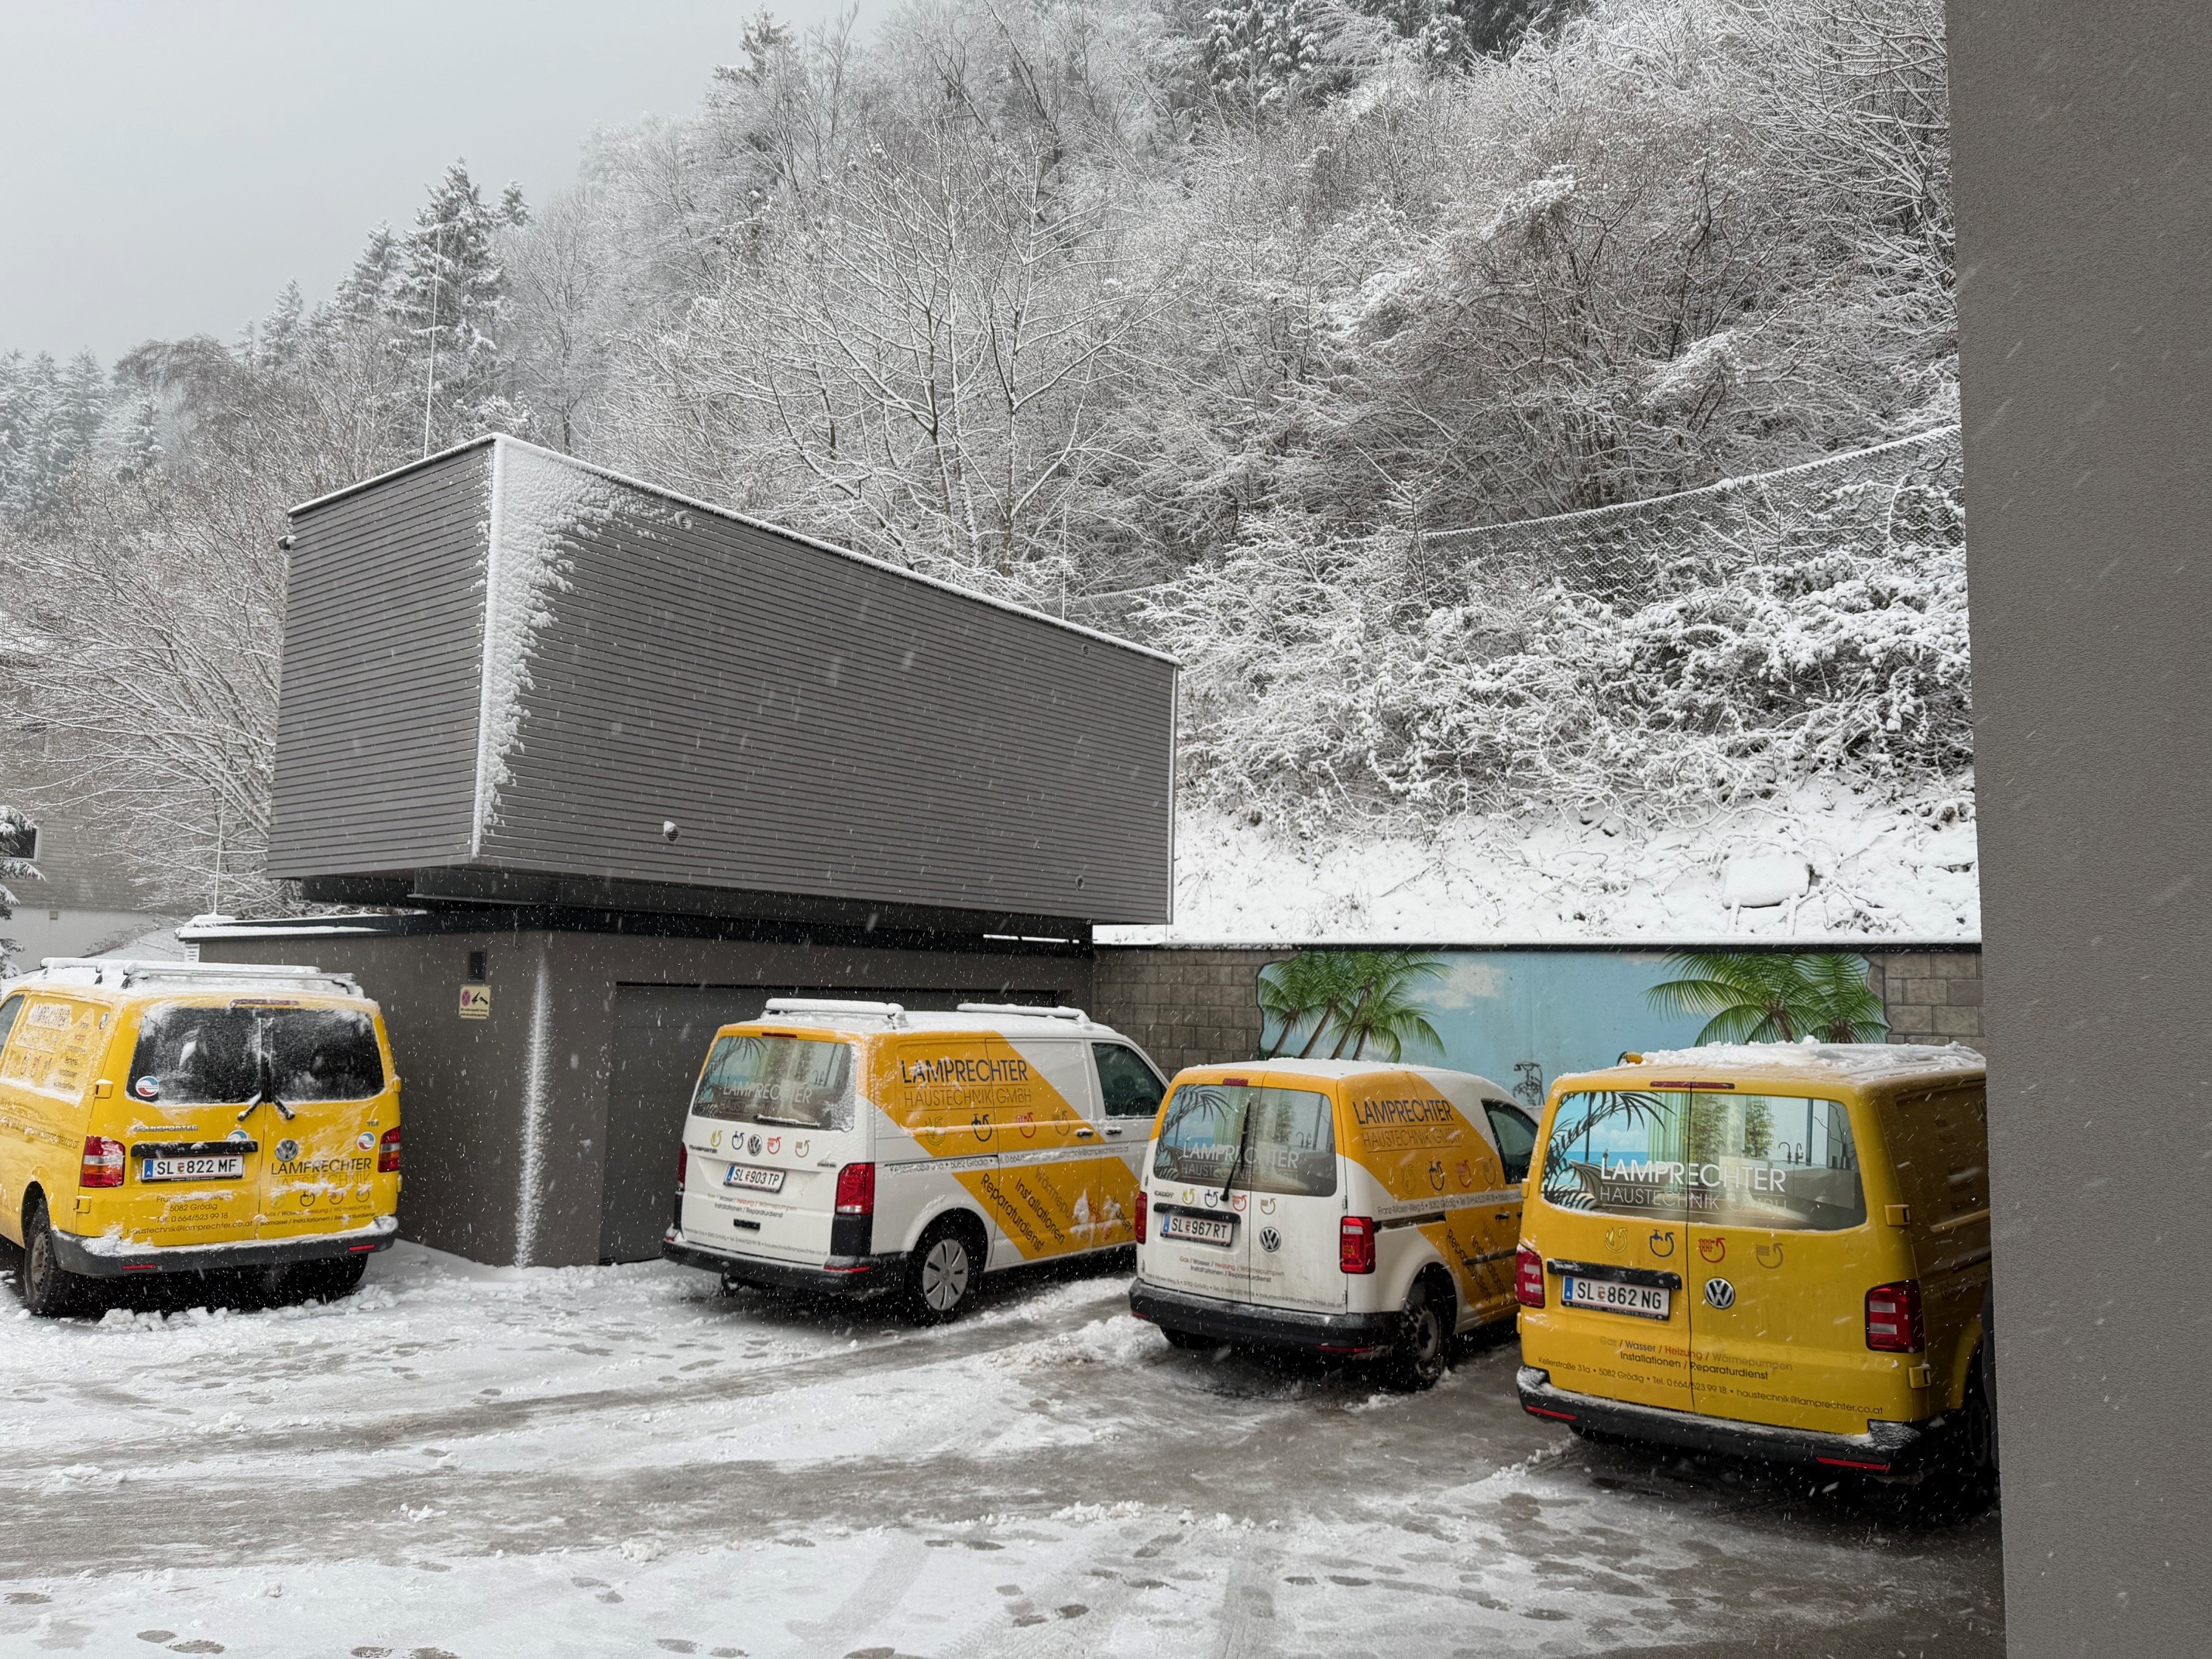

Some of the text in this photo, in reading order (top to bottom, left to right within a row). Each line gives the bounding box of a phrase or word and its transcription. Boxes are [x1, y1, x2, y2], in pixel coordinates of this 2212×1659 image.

[901, 1060, 1029, 1084] LAMPRECHTER
[904, 1087, 1032, 1108] HAUSTECHNIK GMBH
[1352, 1099, 1455, 1125] LAMPRECHTER
[1362, 1128, 1432, 1149] HAUSTECHNIK
[157, 1159, 237, 1175] SL 822 MF
[733, 1168, 780, 1186] SL 903 TP
[1600, 1157, 1786, 1193] LAMPRECHTER
[1600, 1186, 1719, 1210] HAUSTECHNIK
[177, 1213, 208, 1222] 664/523
[981, 1173, 1046, 1252] Reparaturdienst
[1015, 1177, 1065, 1245] Installationen
[1171, 1218, 1228, 1239] SL 967 RT
[1577, 1282, 1662, 1310] SL 862 NG
[1620, 1351, 1681, 1369] Installationen
[1691, 1361, 1768, 1380] Reparaturdienst
[1624, 1340, 1656, 1353] Wasser
[1664, 1345, 1703, 1362] Heizung
[1712, 1353, 1793, 1373] Wärmepumpen
[1577, 1363, 1591, 1373] 31a
[1599, 1367, 1616, 1379] 5082
[1617, 1371, 1644, 1384] Grödig
[1653, 1376, 1665, 1386] Tel.
[1667, 1378, 1673, 1387] 0
[1674, 1379, 1706, 1392] 664/523
[1707, 1384, 1717, 1393] 99
[1719, 1386, 1728, 1395] 18
[1736, 1388, 1884, 1415] haustechnik@lamprechter.co.at
